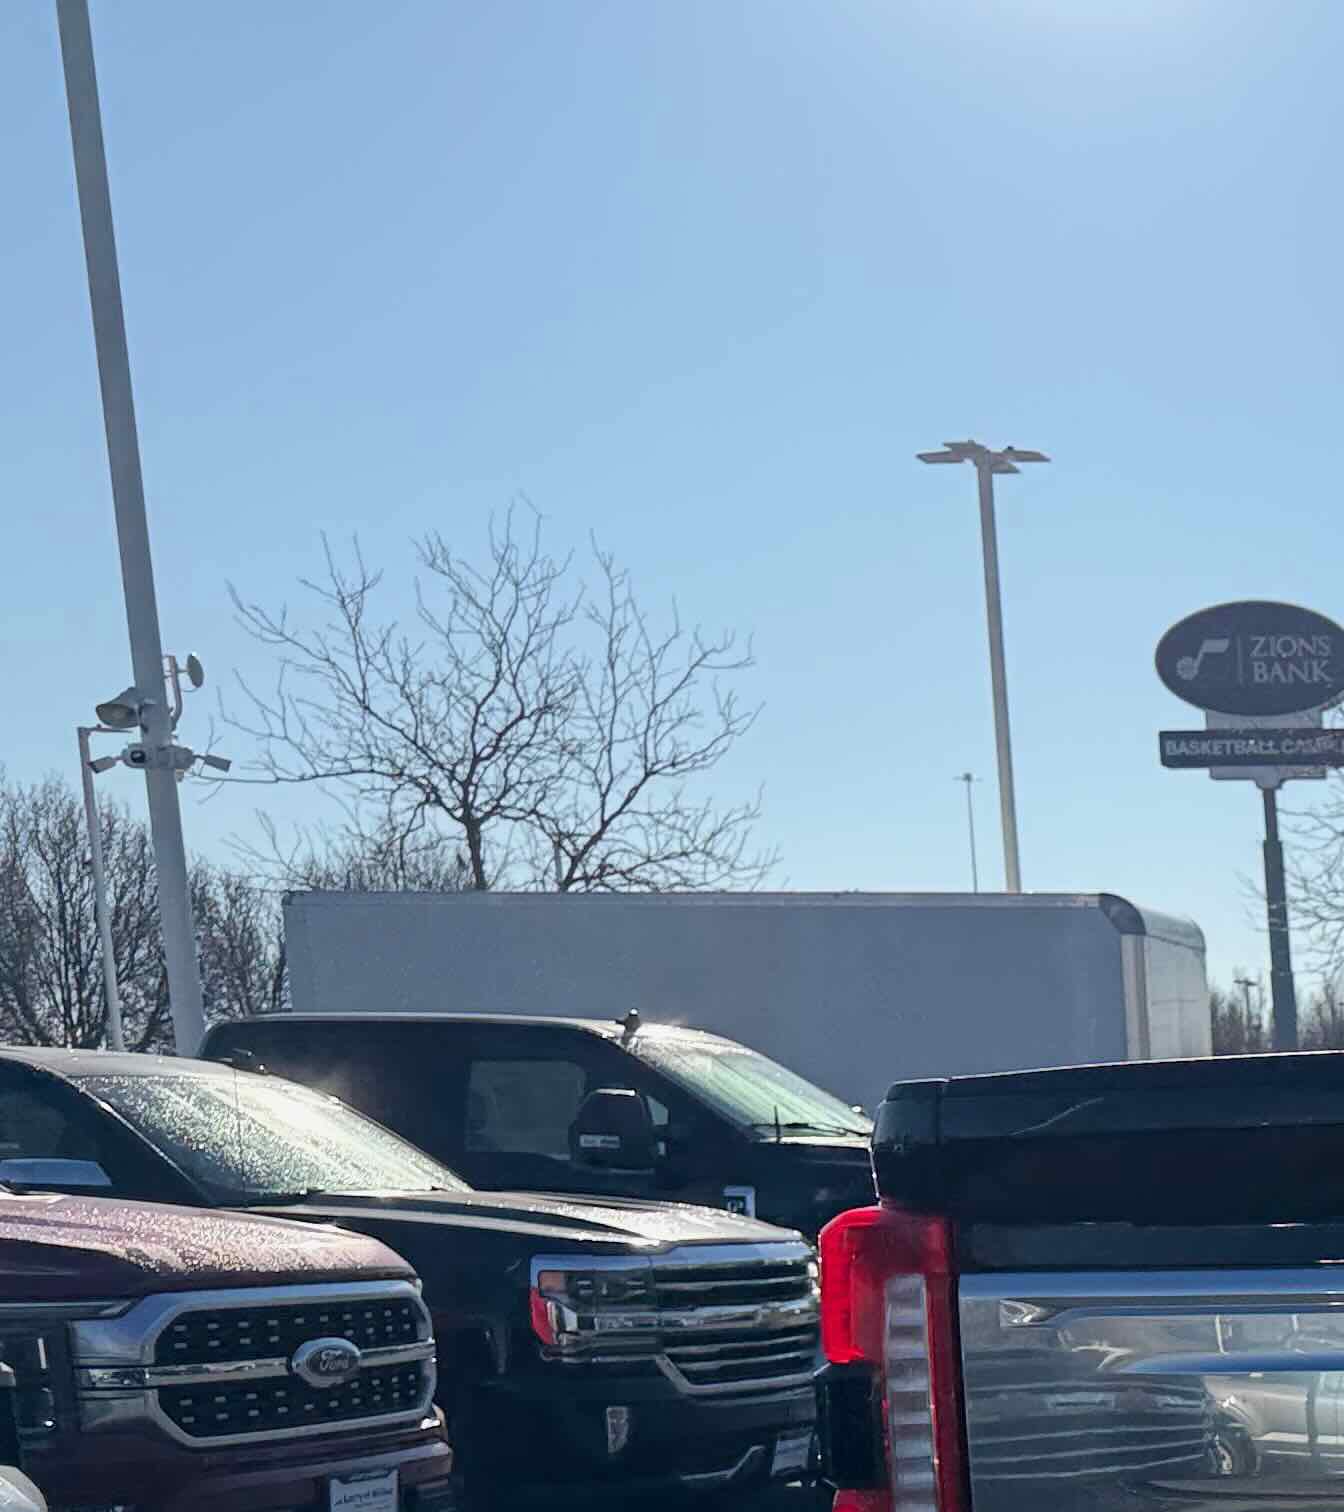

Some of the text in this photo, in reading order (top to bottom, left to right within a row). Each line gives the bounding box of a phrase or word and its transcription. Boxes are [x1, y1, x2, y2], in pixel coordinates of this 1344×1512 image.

[1250, 635, 1332, 660] ZIONS
[1251, 661, 1331, 685] BANK
[1165, 738, 1280, 756] BASKETBALL
